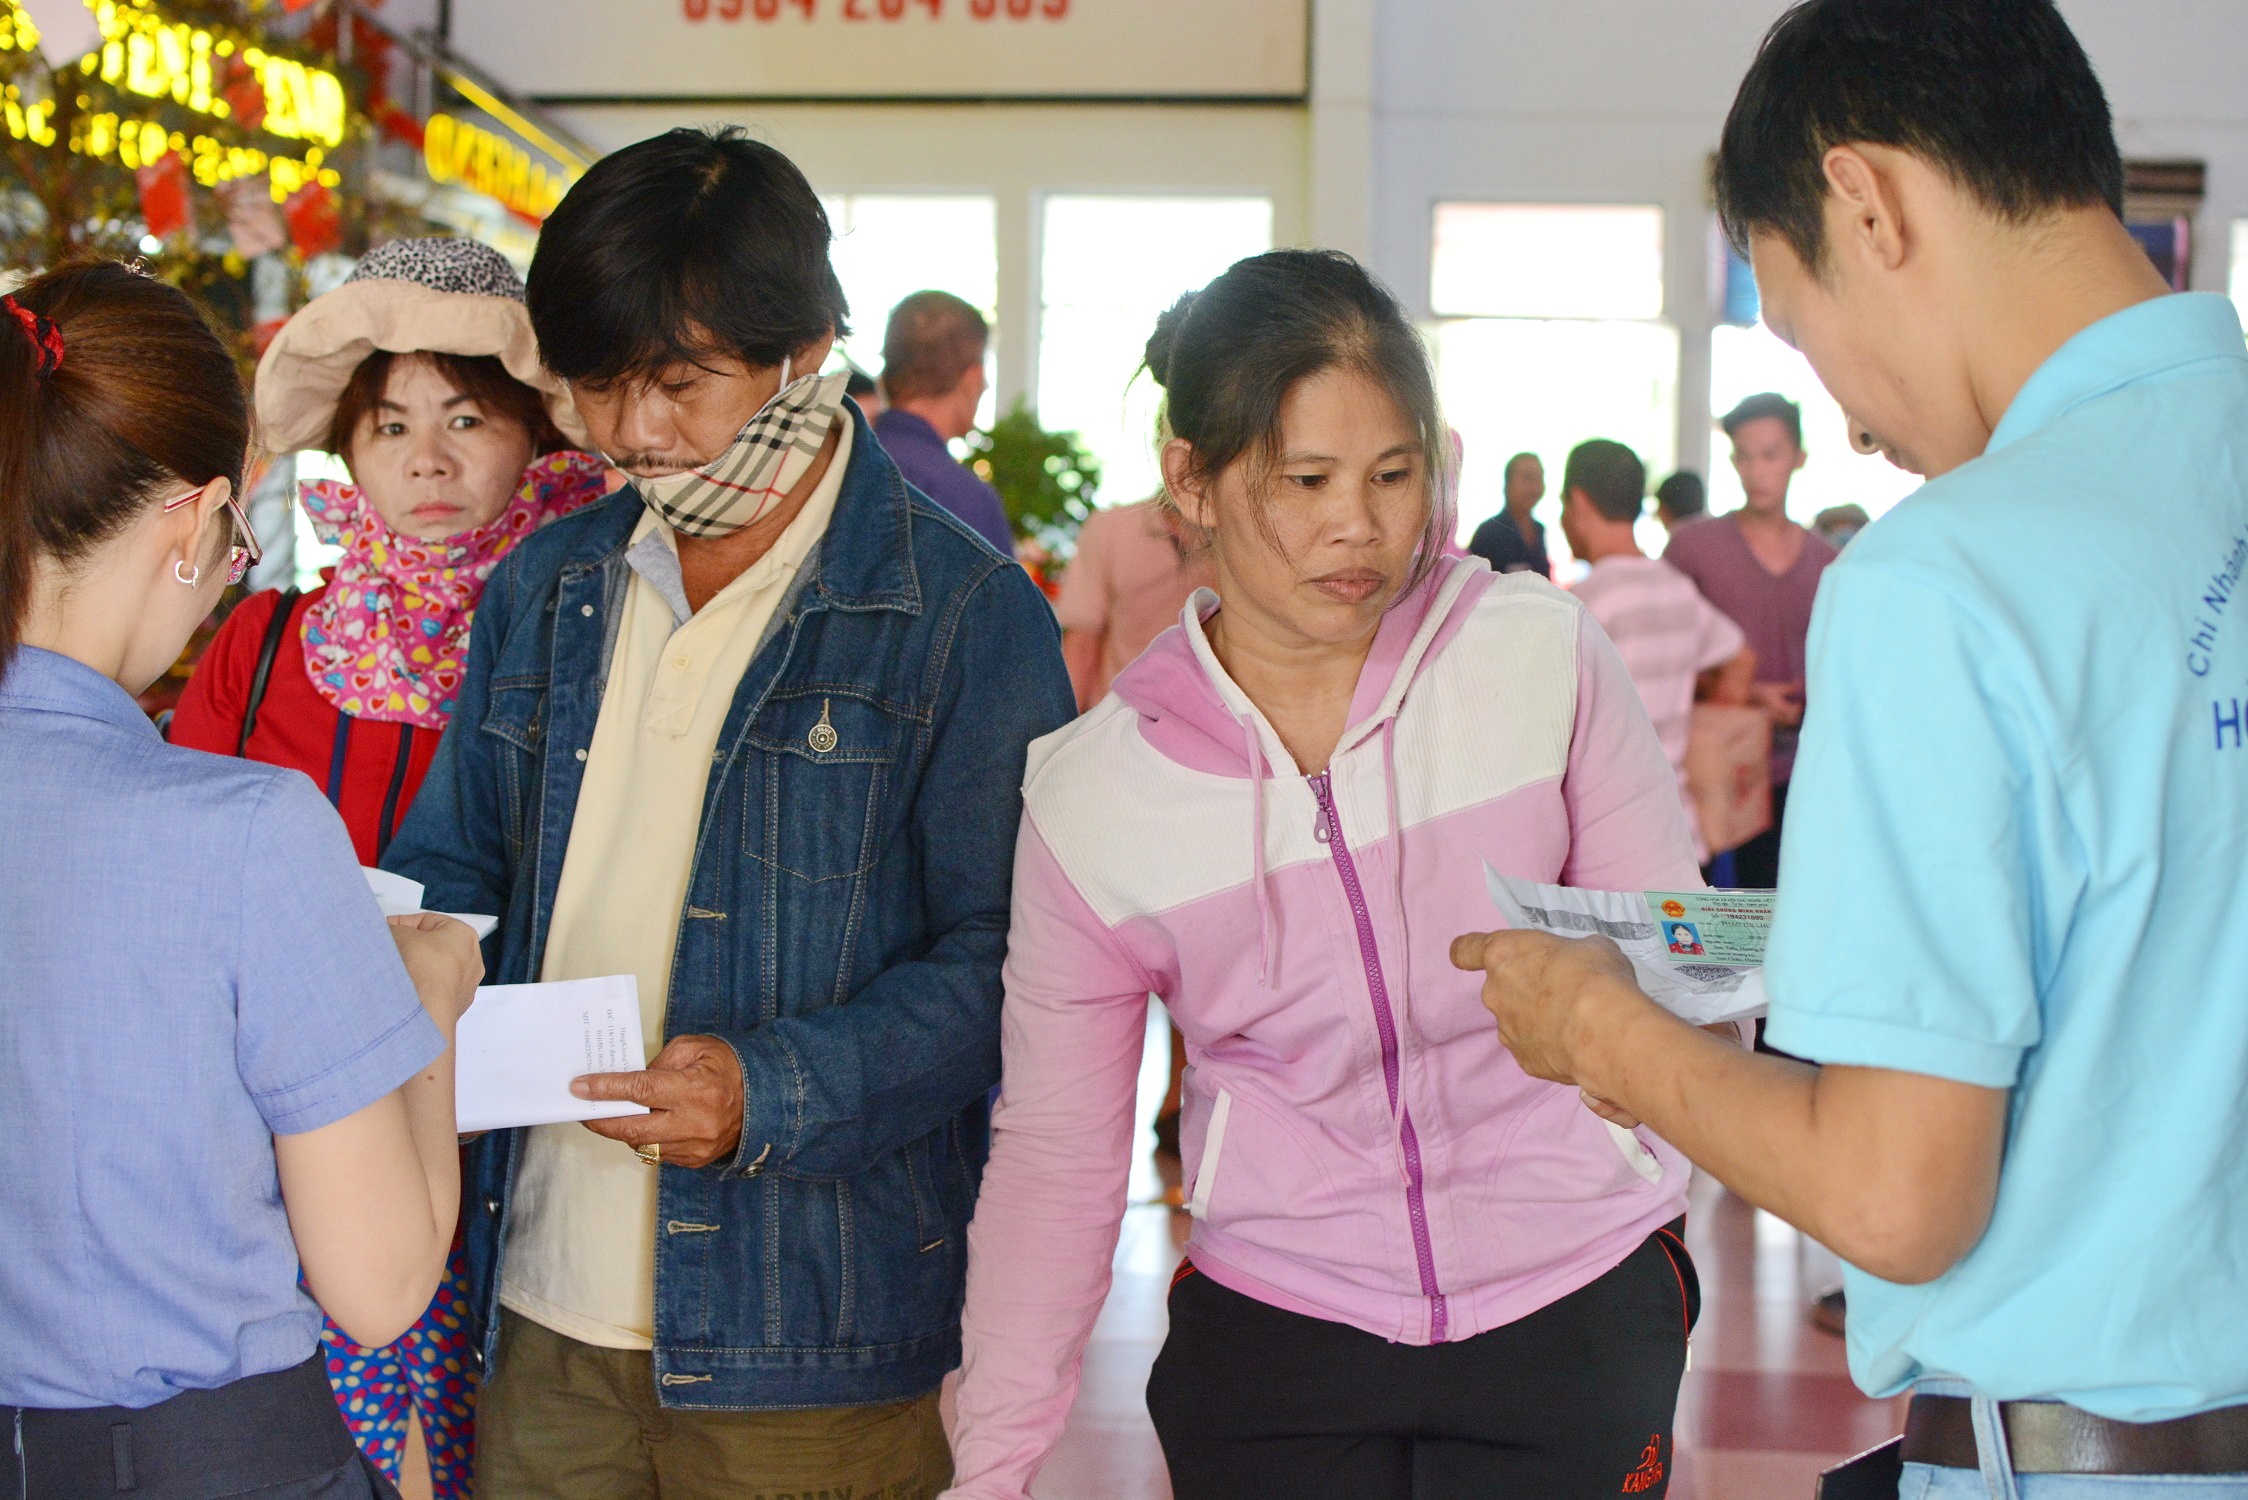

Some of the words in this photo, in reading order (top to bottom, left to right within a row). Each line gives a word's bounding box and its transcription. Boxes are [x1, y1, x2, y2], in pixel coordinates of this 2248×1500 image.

[2186, 616, 2217, 677] Chi
[2213, 698, 2248, 750] H
[620, 1027, 629, 1072] HangKhongVie
